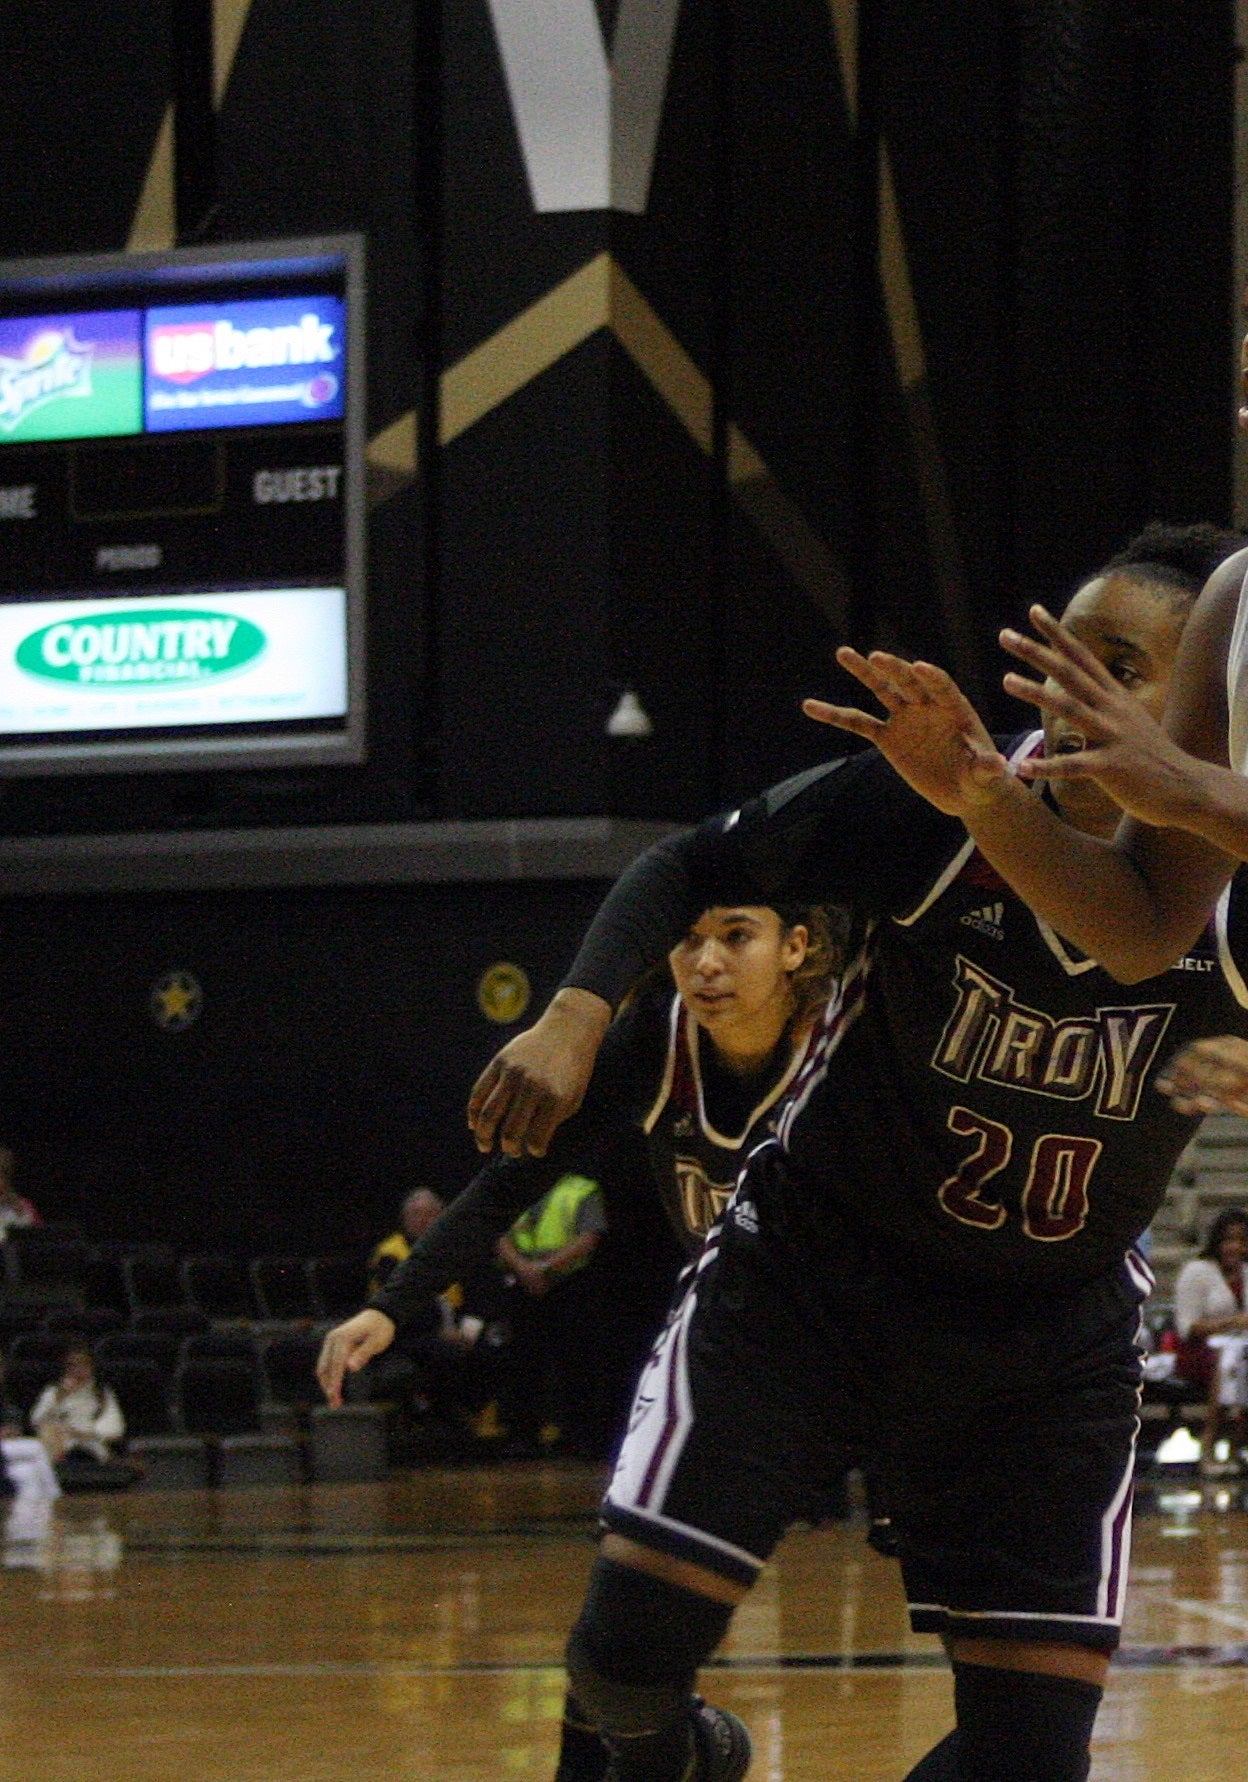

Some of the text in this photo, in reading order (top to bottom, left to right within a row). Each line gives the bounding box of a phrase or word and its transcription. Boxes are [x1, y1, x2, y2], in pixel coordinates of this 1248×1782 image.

[254, 466, 340, 504] GUEST
[42, 618, 239, 668] COUNTRY
[79, 661, 201, 683] FINANCIAL
[931, 953, 1177, 1121] TROY
[938, 1105, 1102, 1242] 20
